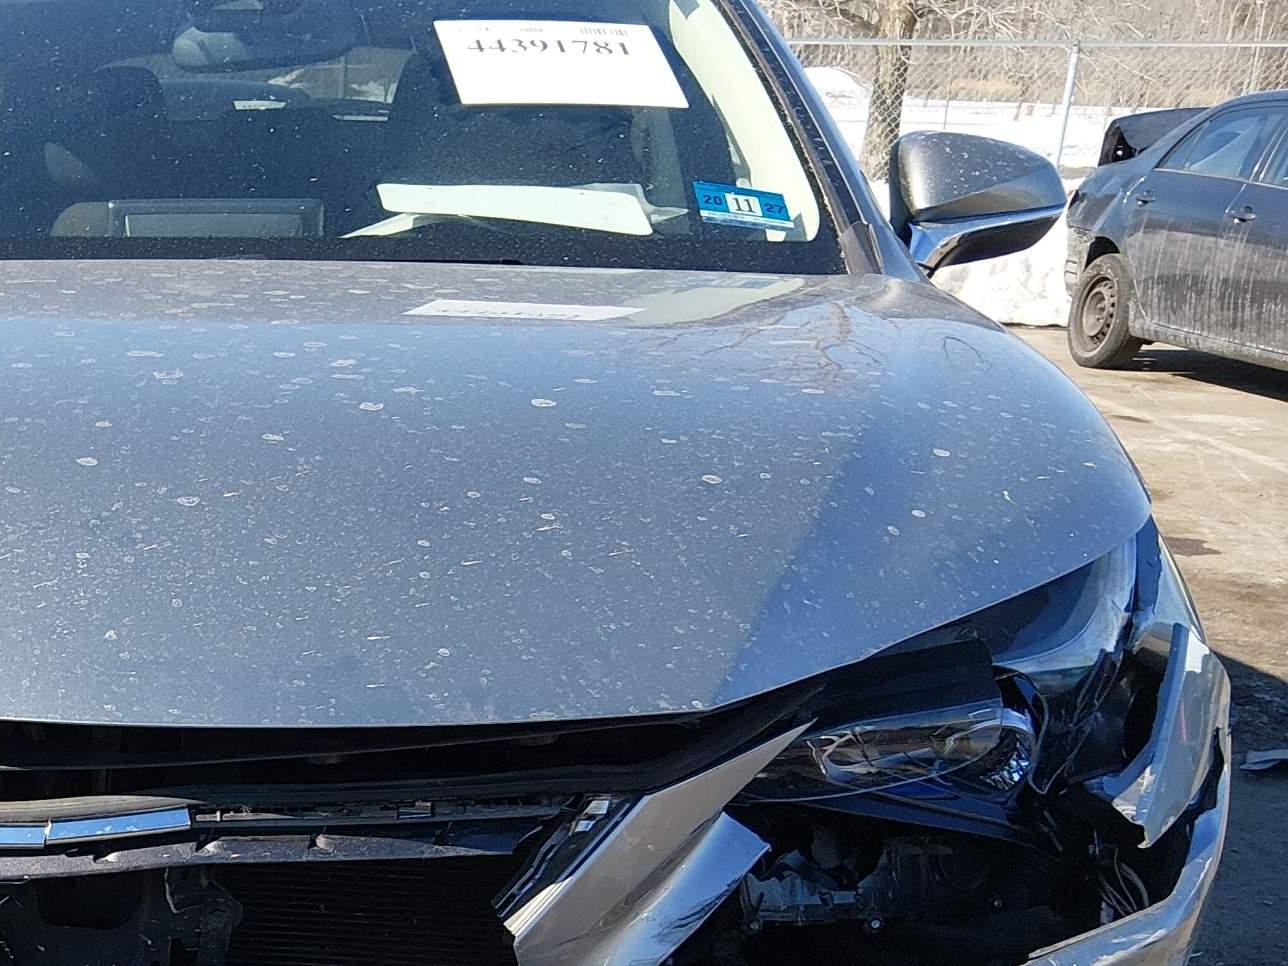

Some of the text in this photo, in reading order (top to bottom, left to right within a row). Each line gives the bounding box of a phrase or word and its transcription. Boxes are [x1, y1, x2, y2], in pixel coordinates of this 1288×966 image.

[467, 39, 630, 56] 44391781
[703, 194, 785, 215] 20 11 27
